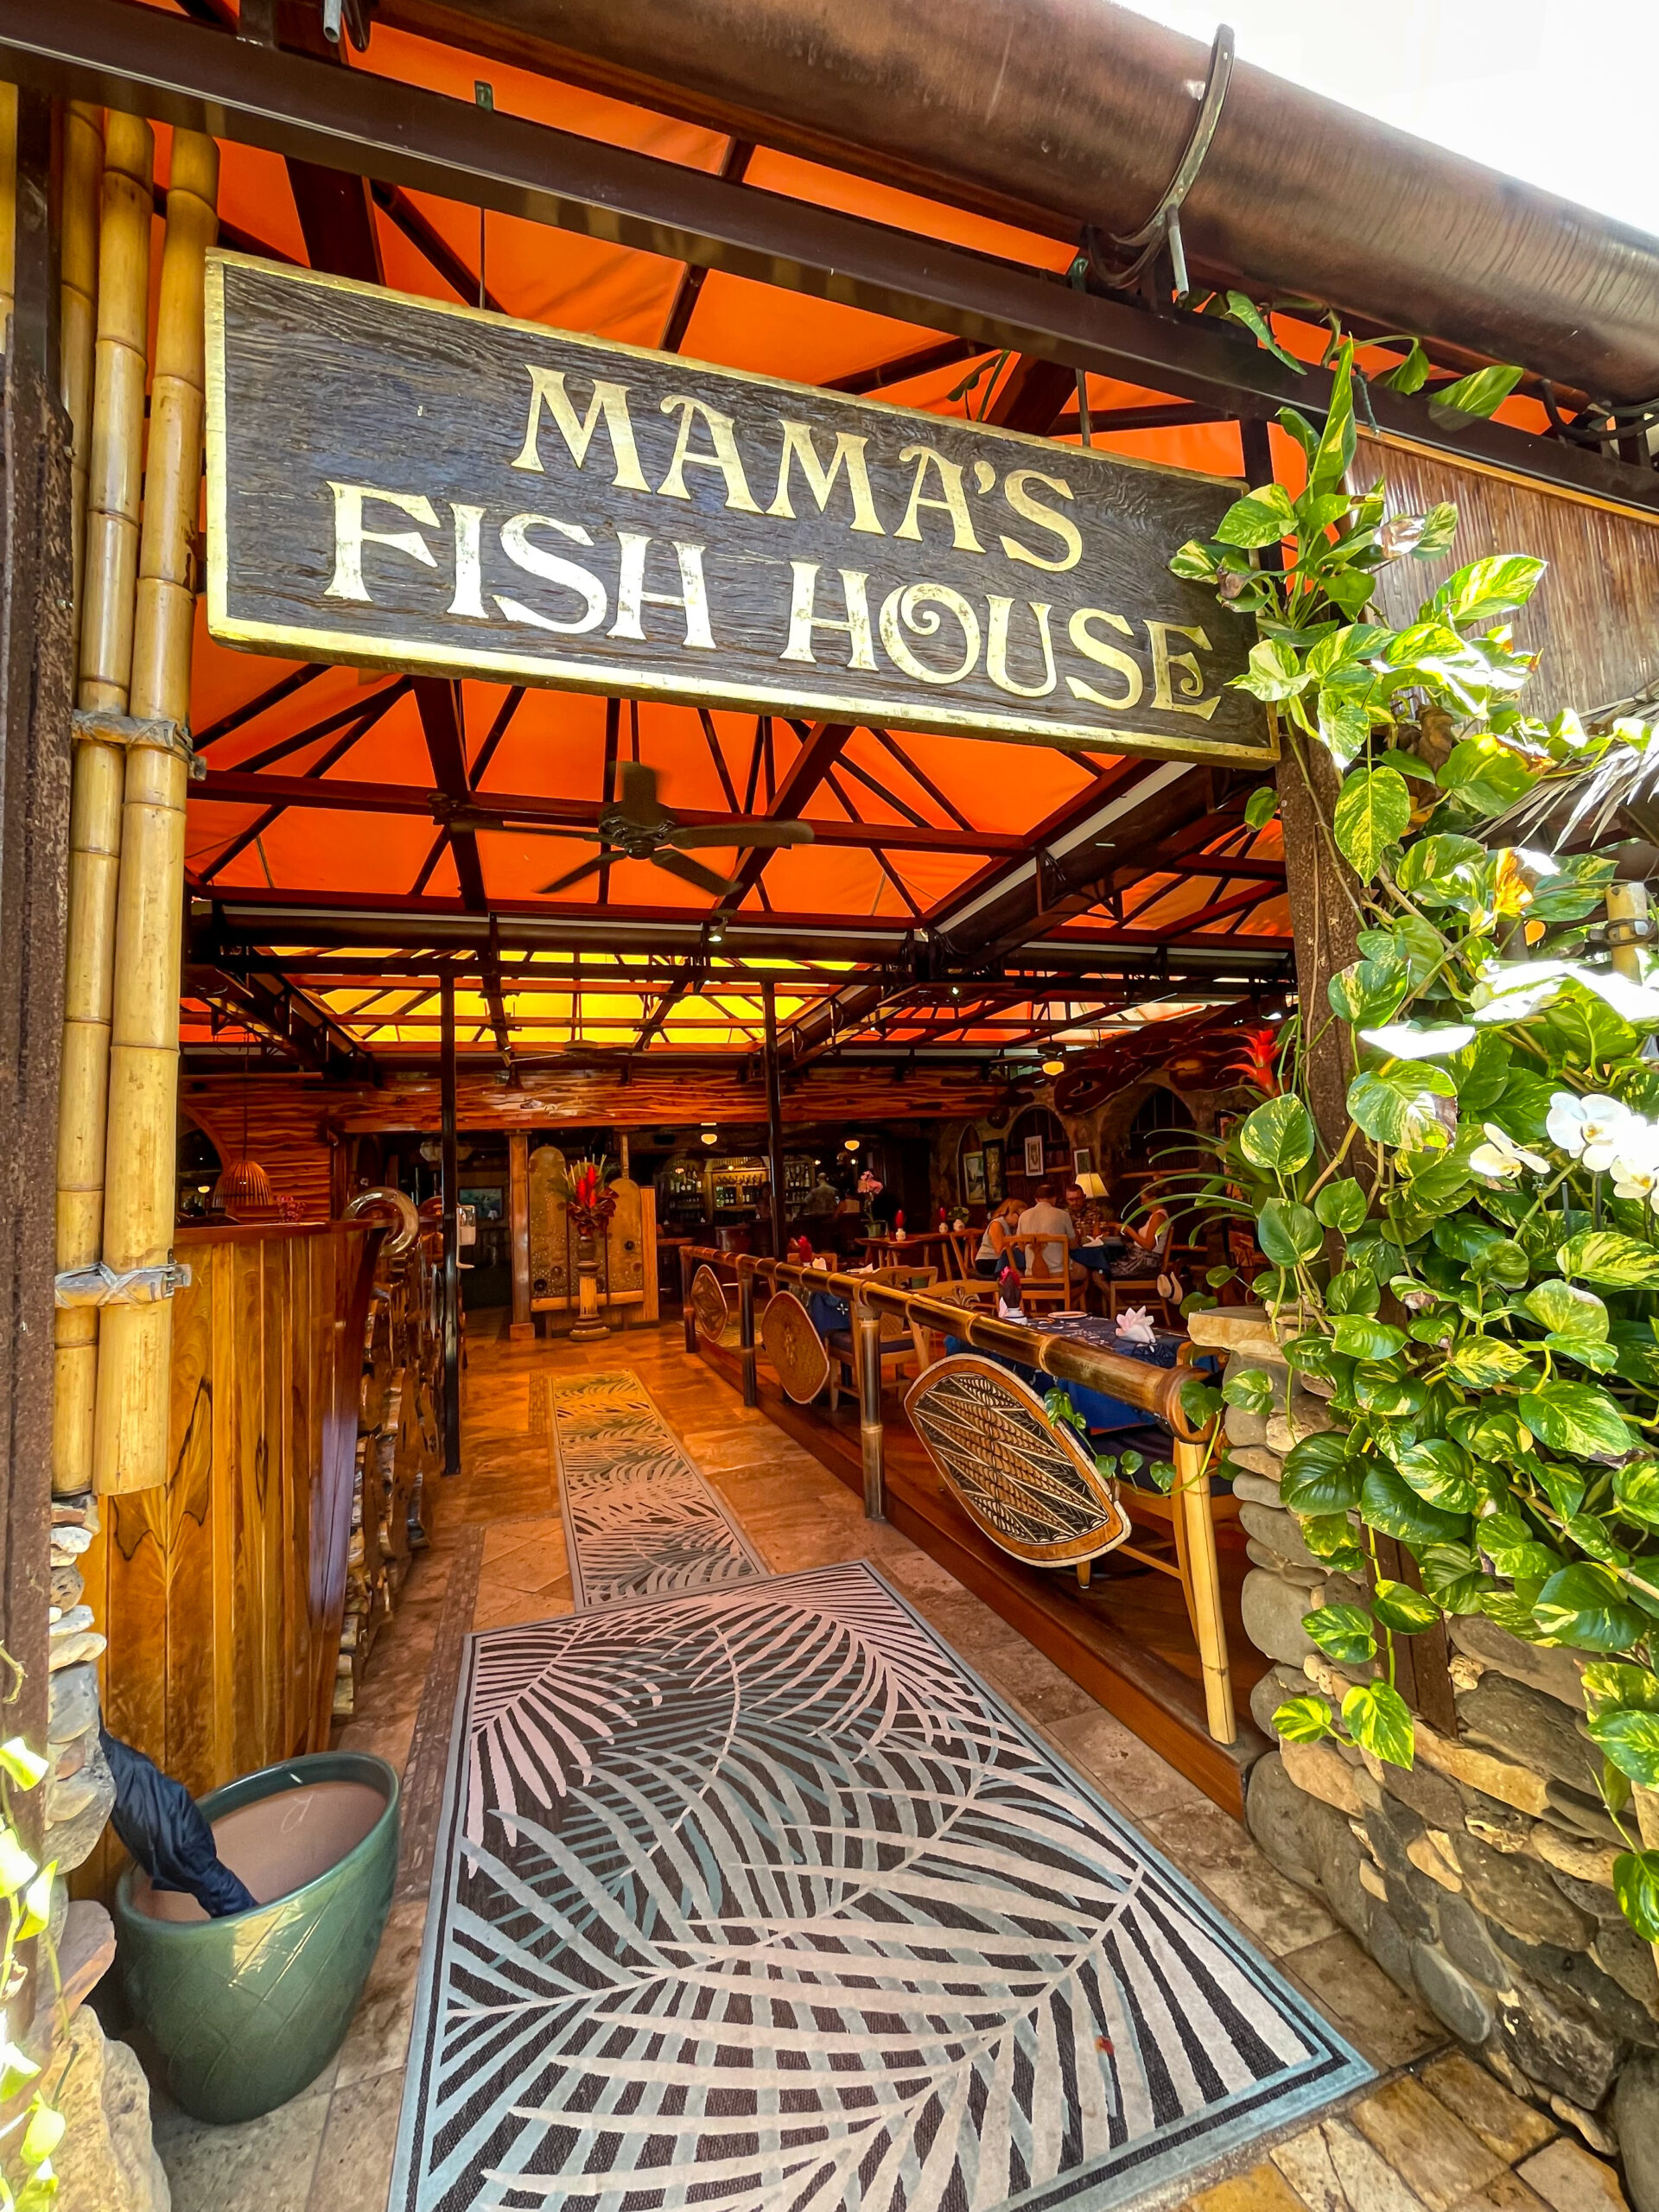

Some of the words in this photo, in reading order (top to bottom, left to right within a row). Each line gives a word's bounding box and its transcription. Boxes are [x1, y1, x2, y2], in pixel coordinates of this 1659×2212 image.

[512, 364, 1083, 572] MAMA'S
[323, 480, 717, 648] FISH
[780, 561, 1222, 721] HOUSE
